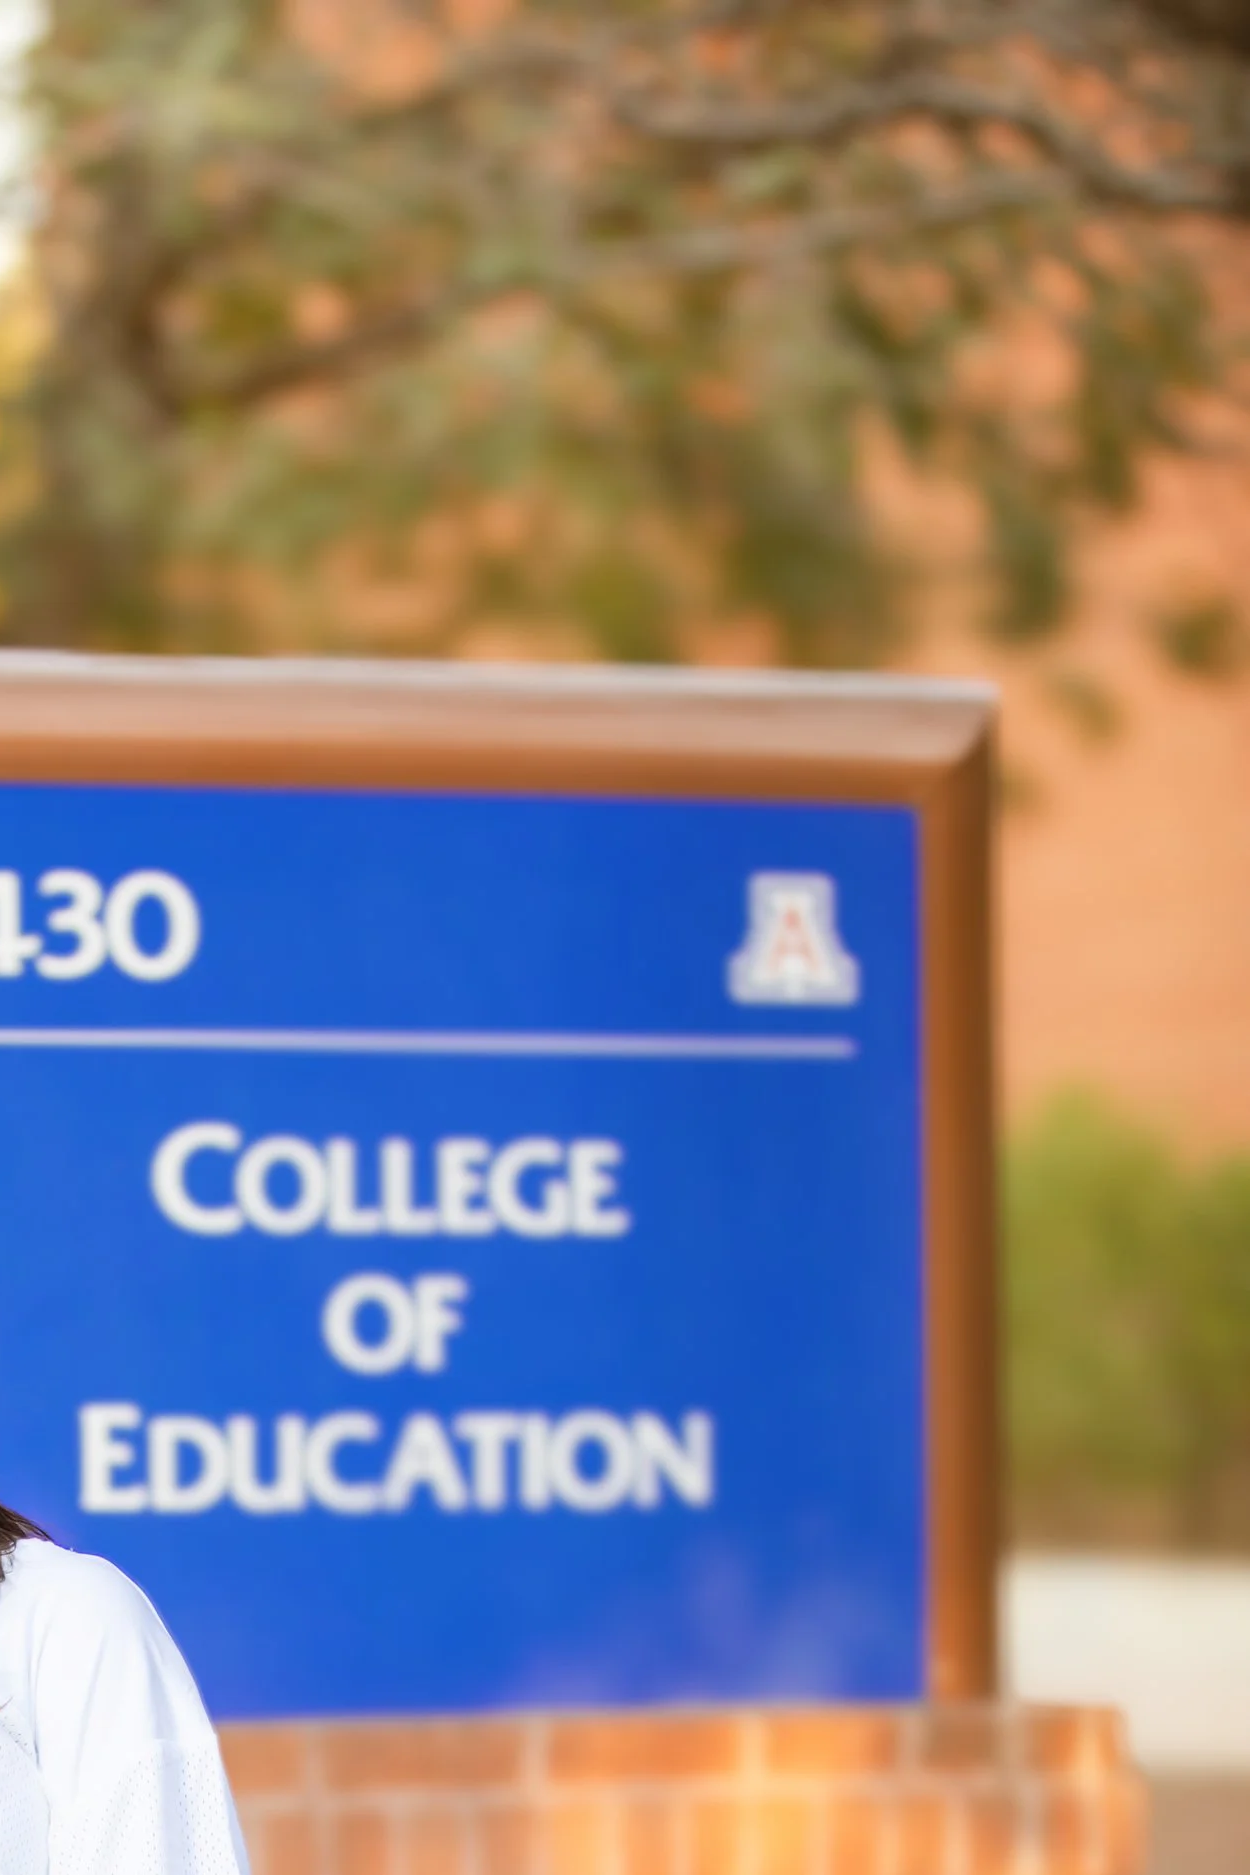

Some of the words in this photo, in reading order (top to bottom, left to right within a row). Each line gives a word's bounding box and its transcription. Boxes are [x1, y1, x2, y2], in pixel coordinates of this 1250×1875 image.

[728, 870, 860, 1006] A
[150, 1121, 631, 1239] COLLEGE
[321, 1273, 469, 1375] OF
[78, 1402, 714, 1515] EDUCATION
